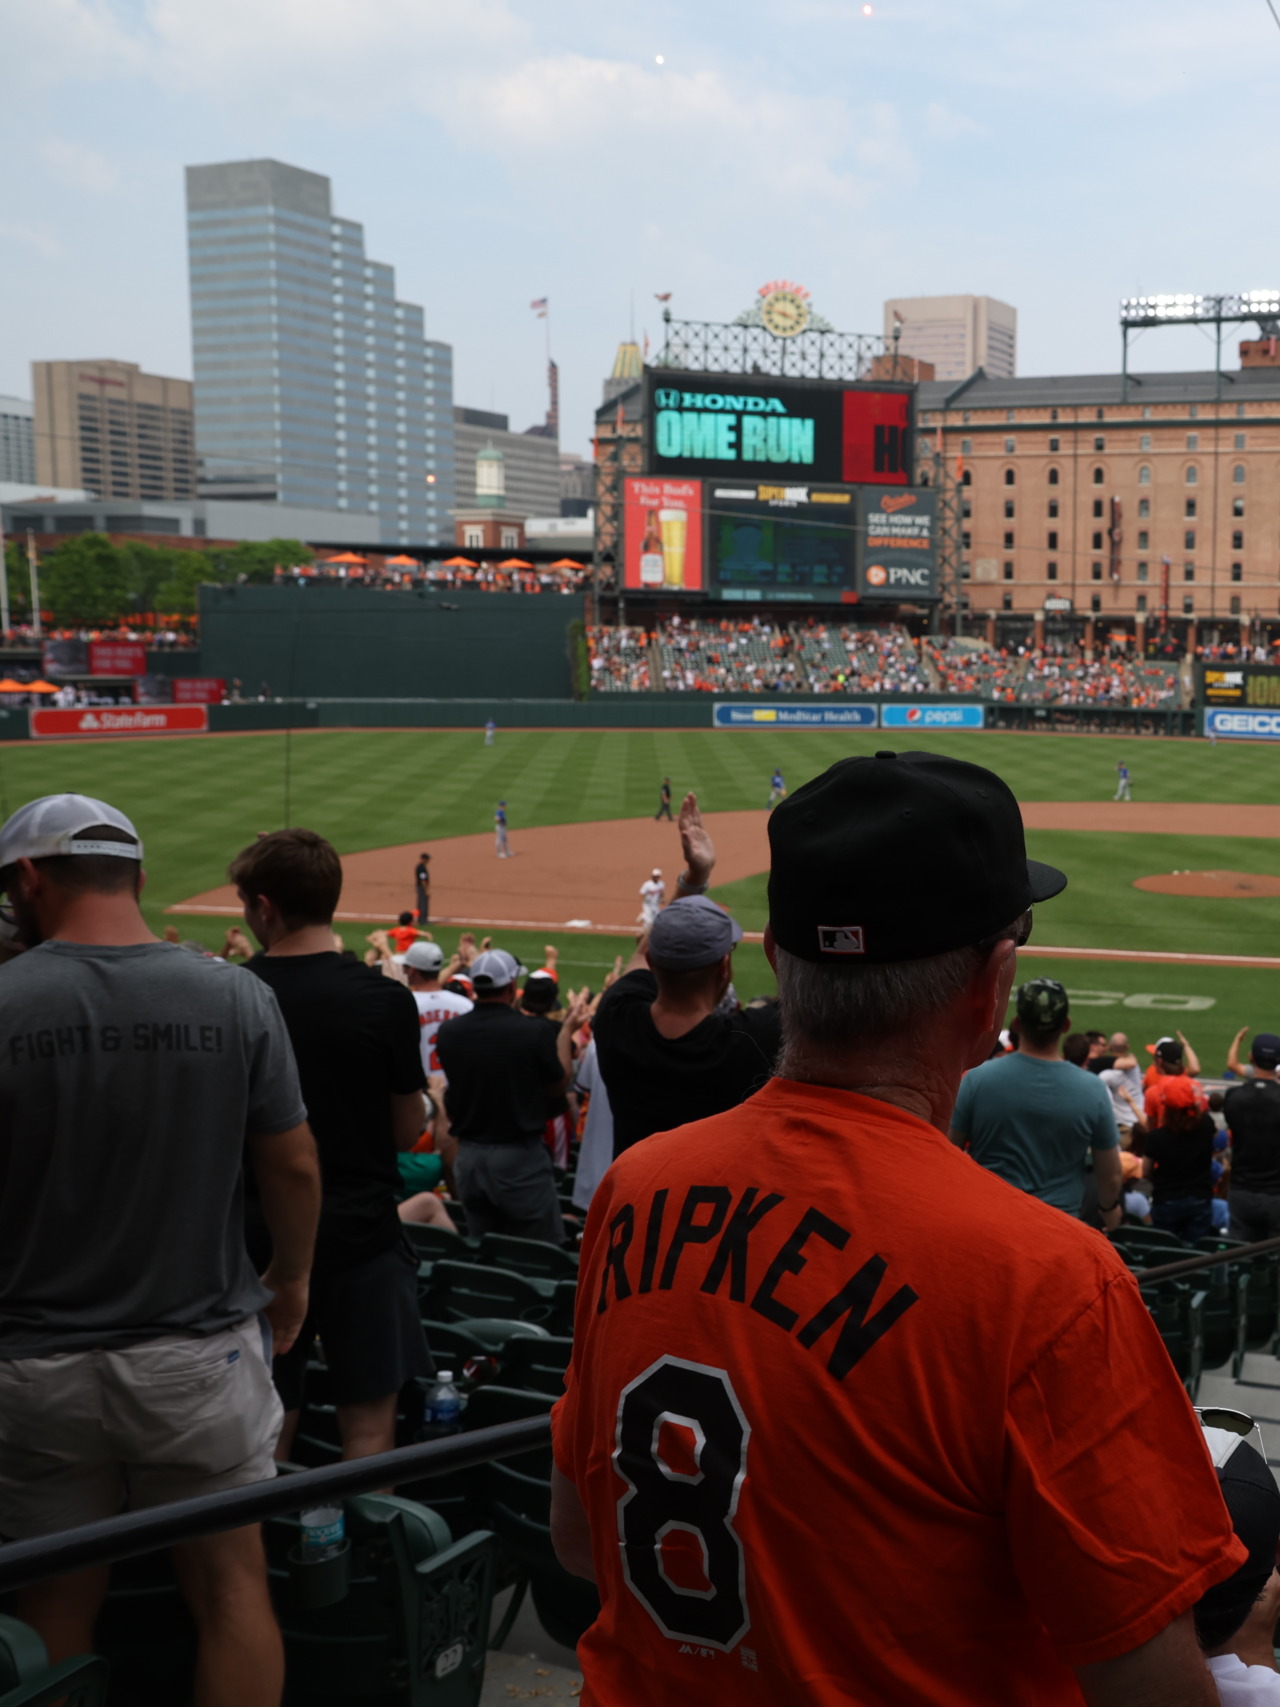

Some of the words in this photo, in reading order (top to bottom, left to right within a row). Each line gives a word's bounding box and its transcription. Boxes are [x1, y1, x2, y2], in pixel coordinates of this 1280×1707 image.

[681, 392, 787, 413] HONDA
[741, 415, 814, 464] RUN
[868, 513, 886, 524] SEE
[888, 514, 912, 525] HOW
[914, 515, 931, 526] WE
[868, 525, 890, 536] CAN
[891, 526, 919, 537] MAKE
[921, 527, 930, 537] A
[867, 536, 930, 549] DIFFERENCE
[888, 567, 930, 585] PNC
[778, 711, 822, 722] MedStar
[824, 711, 861, 722] Health
[925, 709, 962, 723] pepsi
[9, 1025, 90, 1065] FIGHT
[100, 1026, 121, 1051] &
[133, 1023, 223, 1053] SMILE!
[597, 1185, 919, 1381] RIPKEN
[611, 1354, 751, 1653] 8
